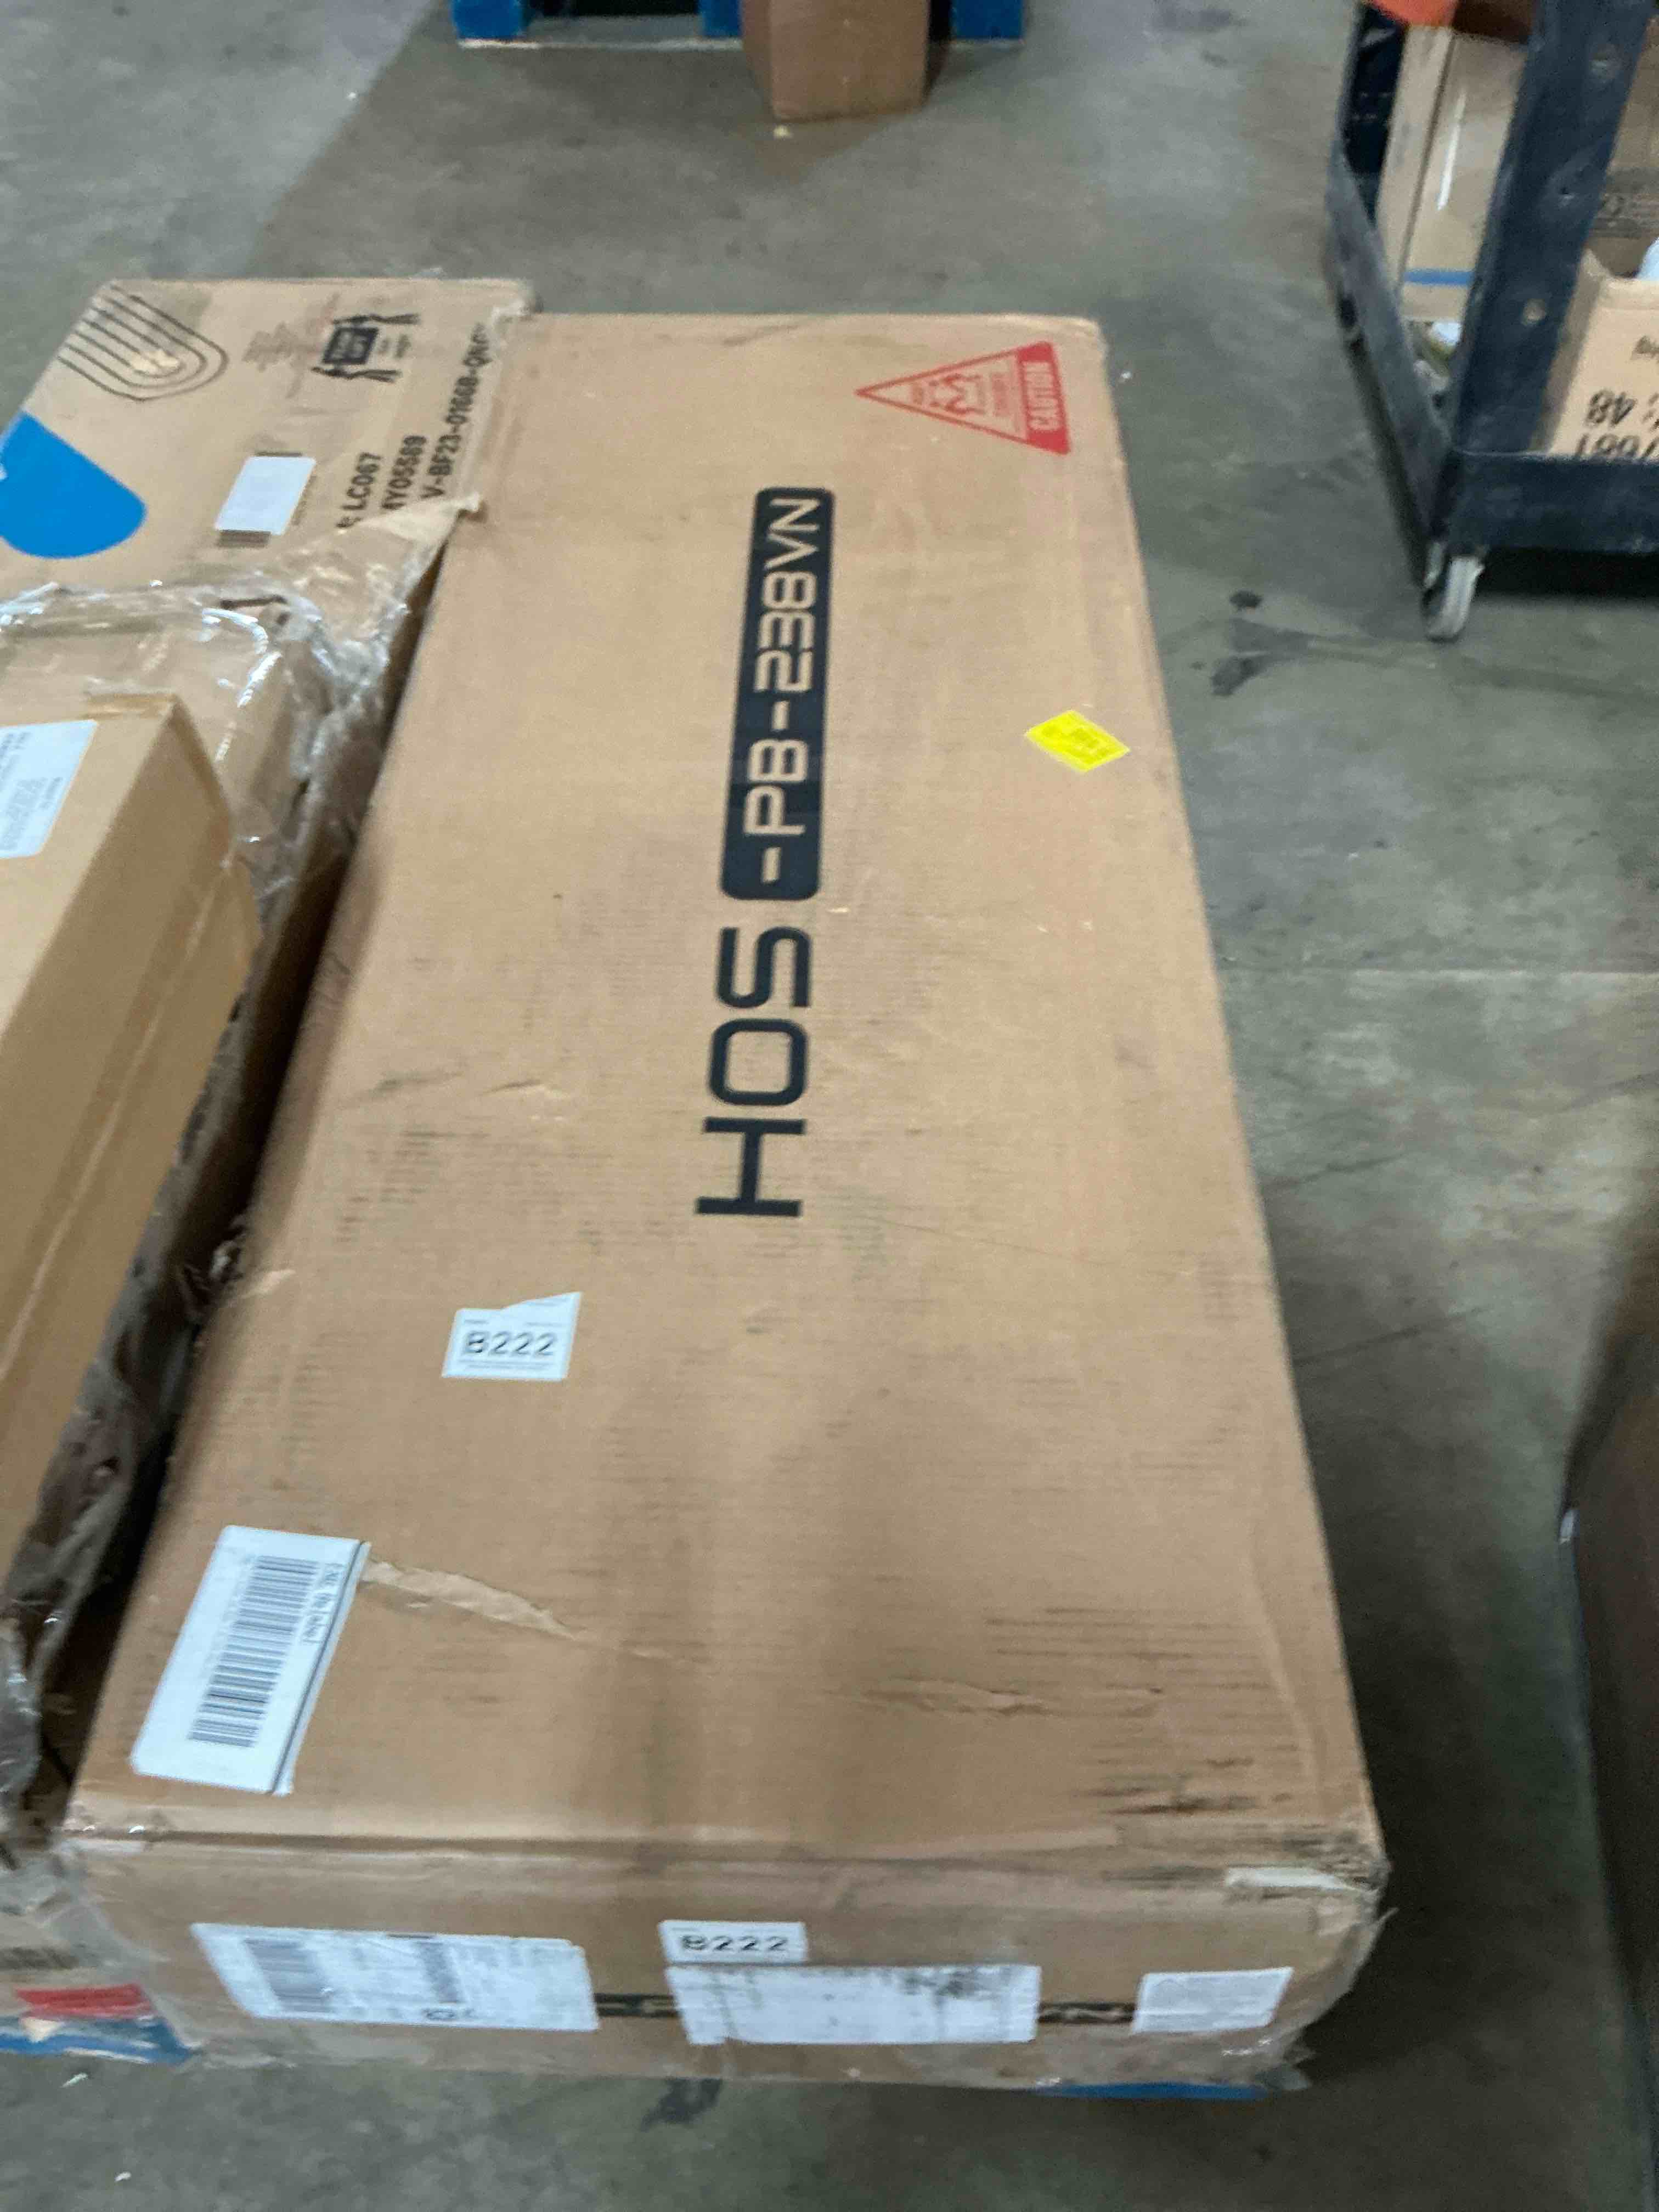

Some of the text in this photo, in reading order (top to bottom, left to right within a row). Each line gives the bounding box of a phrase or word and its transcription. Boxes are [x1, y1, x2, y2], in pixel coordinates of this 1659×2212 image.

[695, 926, 812, 1217] HOS
[461, 1330, 558, 1357] 8222
[680, 1934, 789, 1951] 8222
